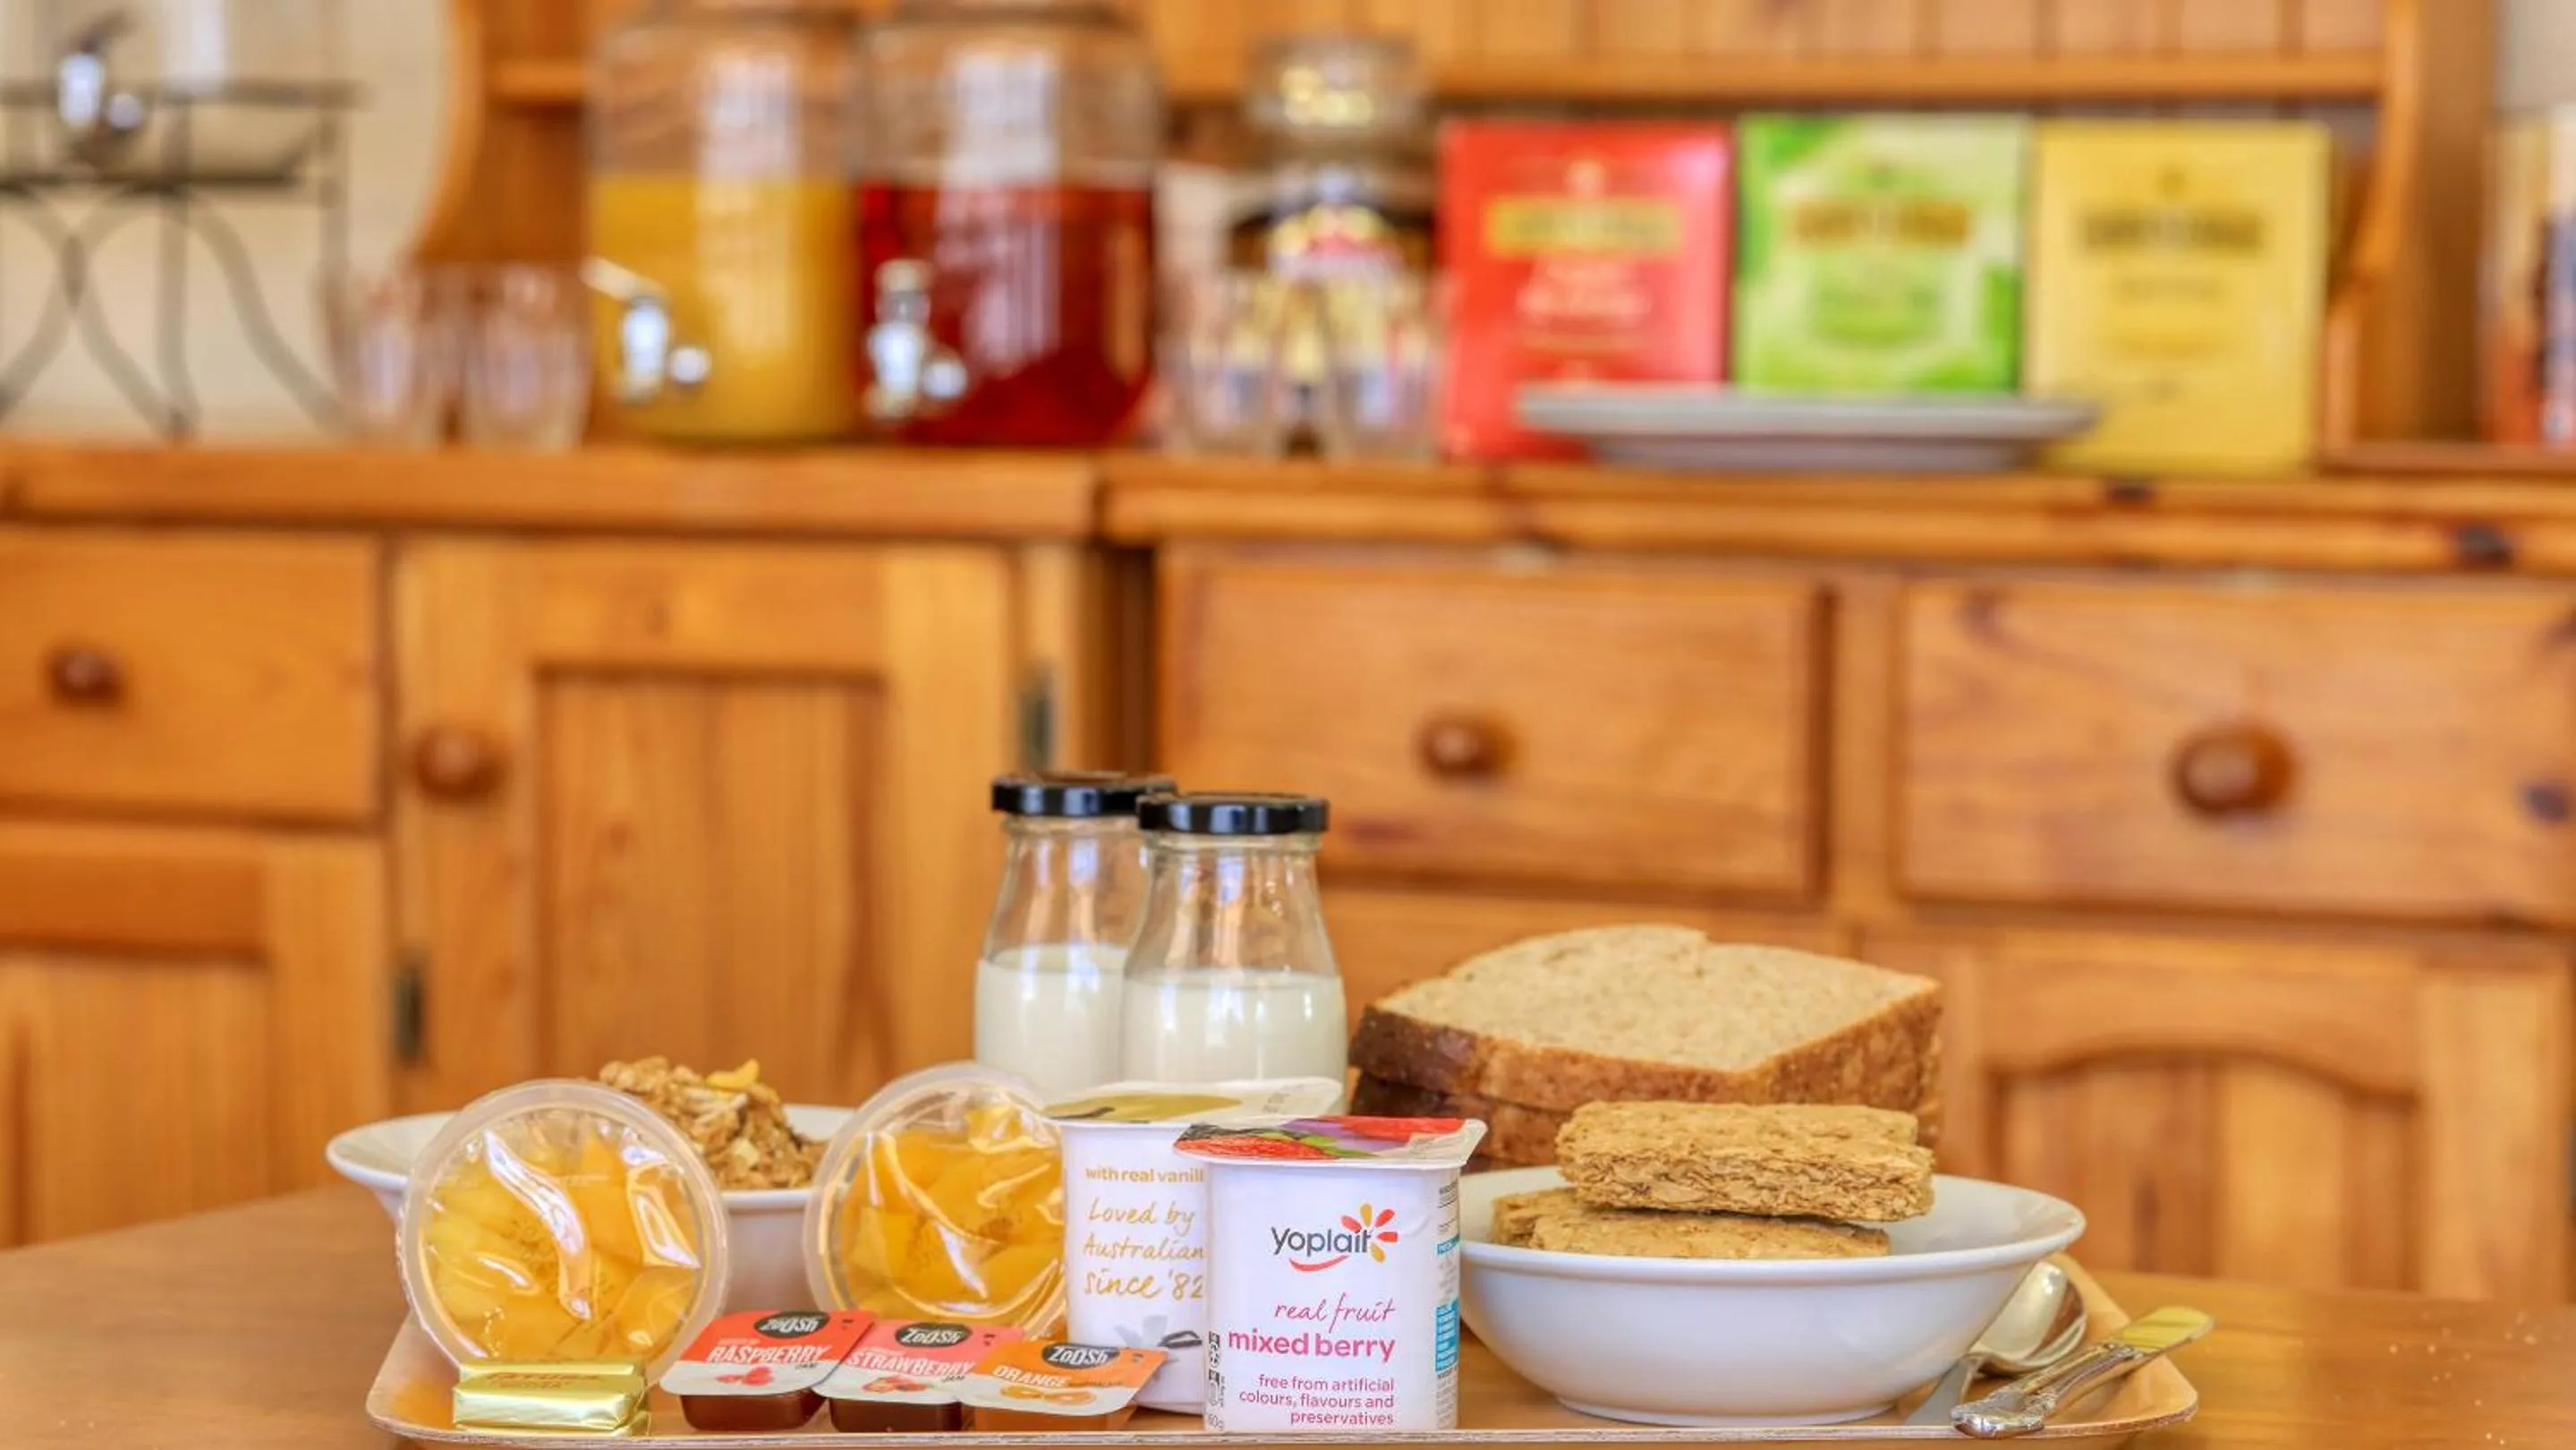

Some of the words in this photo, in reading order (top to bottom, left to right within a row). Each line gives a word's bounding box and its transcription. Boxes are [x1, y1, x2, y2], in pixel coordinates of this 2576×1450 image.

[1085, 1166, 1118, 1181] with
[1121, 1167, 1154, 1182] real
[1158, 1167, 1204, 1183] vanill
[1088, 1196, 1158, 1225] Loved
[1164, 1200, 1195, 1238] by
[1084, 1232, 1205, 1260] Australian
[1084, 1267, 1165, 1300] since
[1273, 1298, 1329, 1322] real
[1329, 1292, 1397, 1335] fruit
[706, 1343, 834, 1366] RASPBERRY
[1228, 1327, 1311, 1356] mixed
[1314, 1333, 1397, 1363] berry
[849, 1350, 977, 1378] STRAWBERRY
[992, 1364, 1074, 1388] ORANGE
[1258, 1373, 1289, 1389] free
[1291, 1375, 1330, 1392] from
[1331, 1377, 1395, 1393] artificial
[1238, 1389, 1298, 1407] colours,
[1300, 1392, 1361, 1409] flavours
[1364, 1395, 1395, 1409] and
[1290, 1411, 1395, 1426] preservatives
